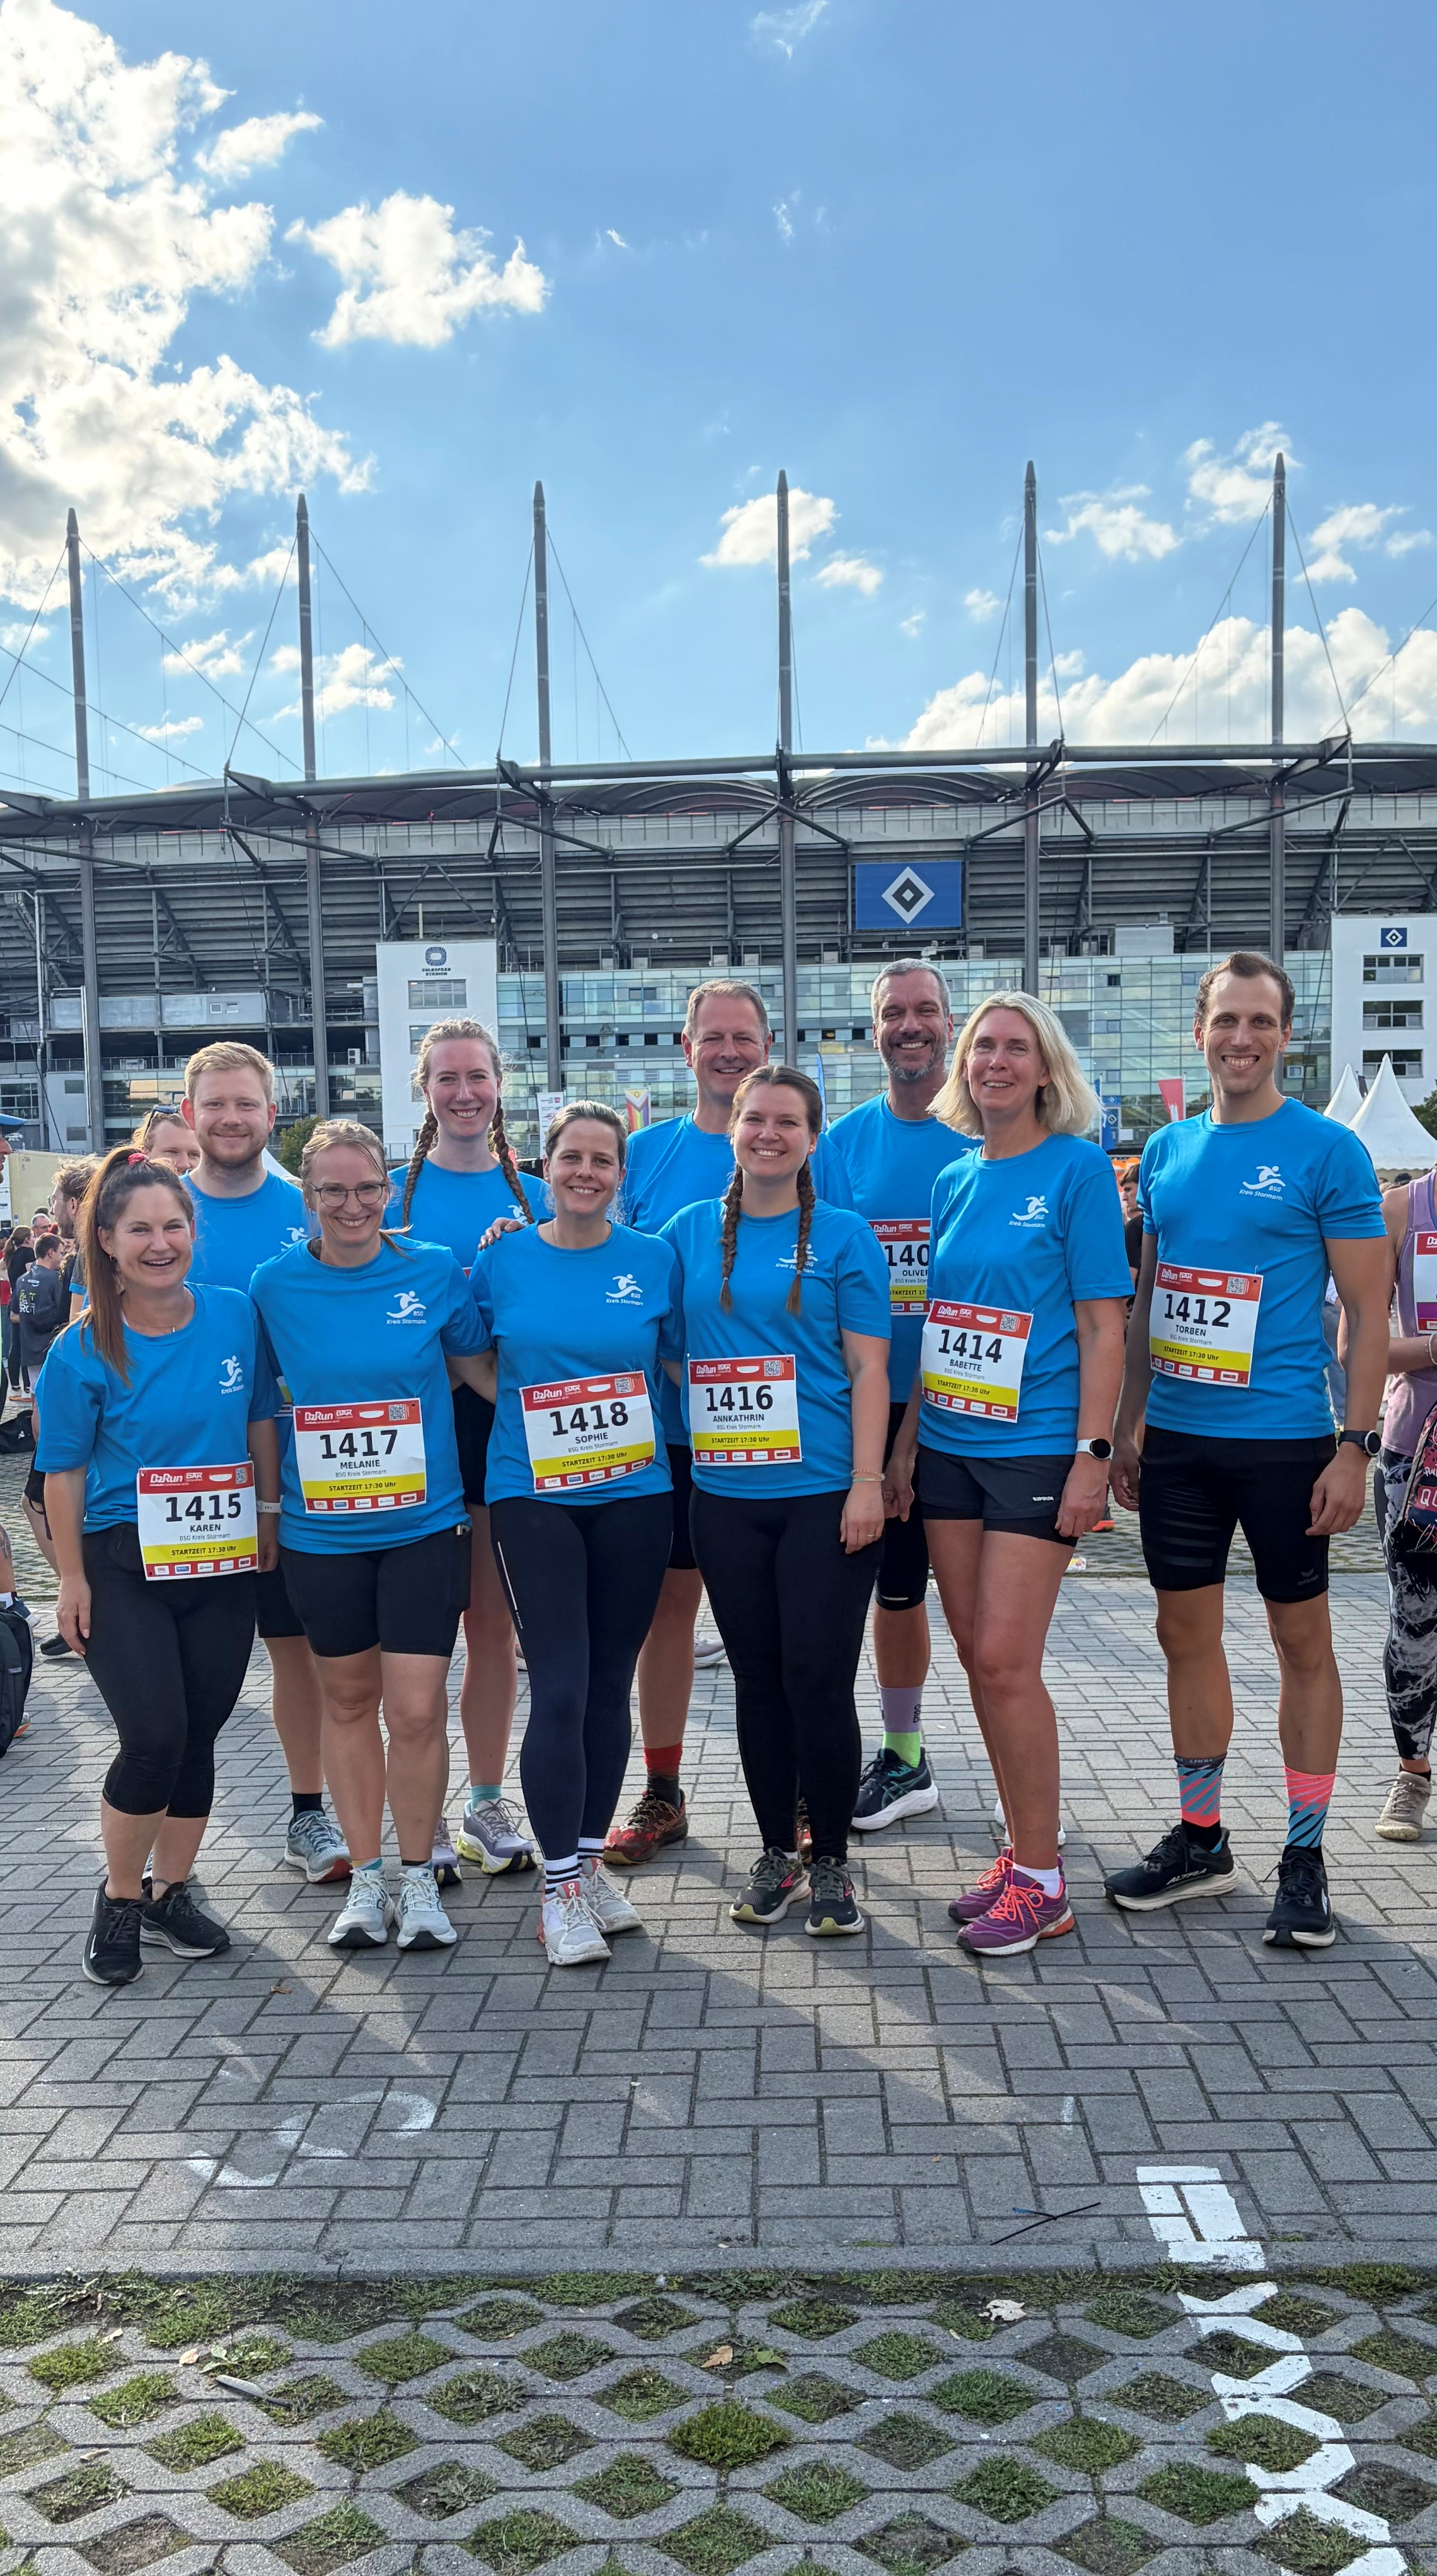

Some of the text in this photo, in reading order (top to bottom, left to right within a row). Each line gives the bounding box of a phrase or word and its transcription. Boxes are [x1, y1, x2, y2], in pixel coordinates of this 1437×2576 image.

[885, 1244, 930, 1267] 140
[1164, 1294, 1231, 1328] 1412
[1175, 1324, 1206, 1336] TORBEN
[938, 1329, 1002, 1363] 1414
[1189, 1337, 1212, 1346] Stormarn
[1164, 1346, 1188, 1356] STARTZEIT
[1189, 1351, 1205, 1359] 17:30
[950, 1359, 982, 1372] BABETTE
[937, 1379, 962, 1390] STARTZEIT
[963, 1385, 978, 1393] 17:30
[706, 1384, 773, 1412] 1416
[550, 1402, 629, 1436] 1418
[713, 1414, 764, 1423] ANNKATHRIN
[320, 1430, 397, 1459] 1417
[575, 1432, 608, 1444] SOPHIE
[340, 1460, 380, 1470] MELANIE
[562, 1457, 595, 1467] STARTZEIT
[597, 1454, 615, 1462] 17:30
[166, 1493, 241, 1522] 1415
[190, 1524, 221, 1532] KAREN
[171, 1547, 206, 1556] STARTZEIT
